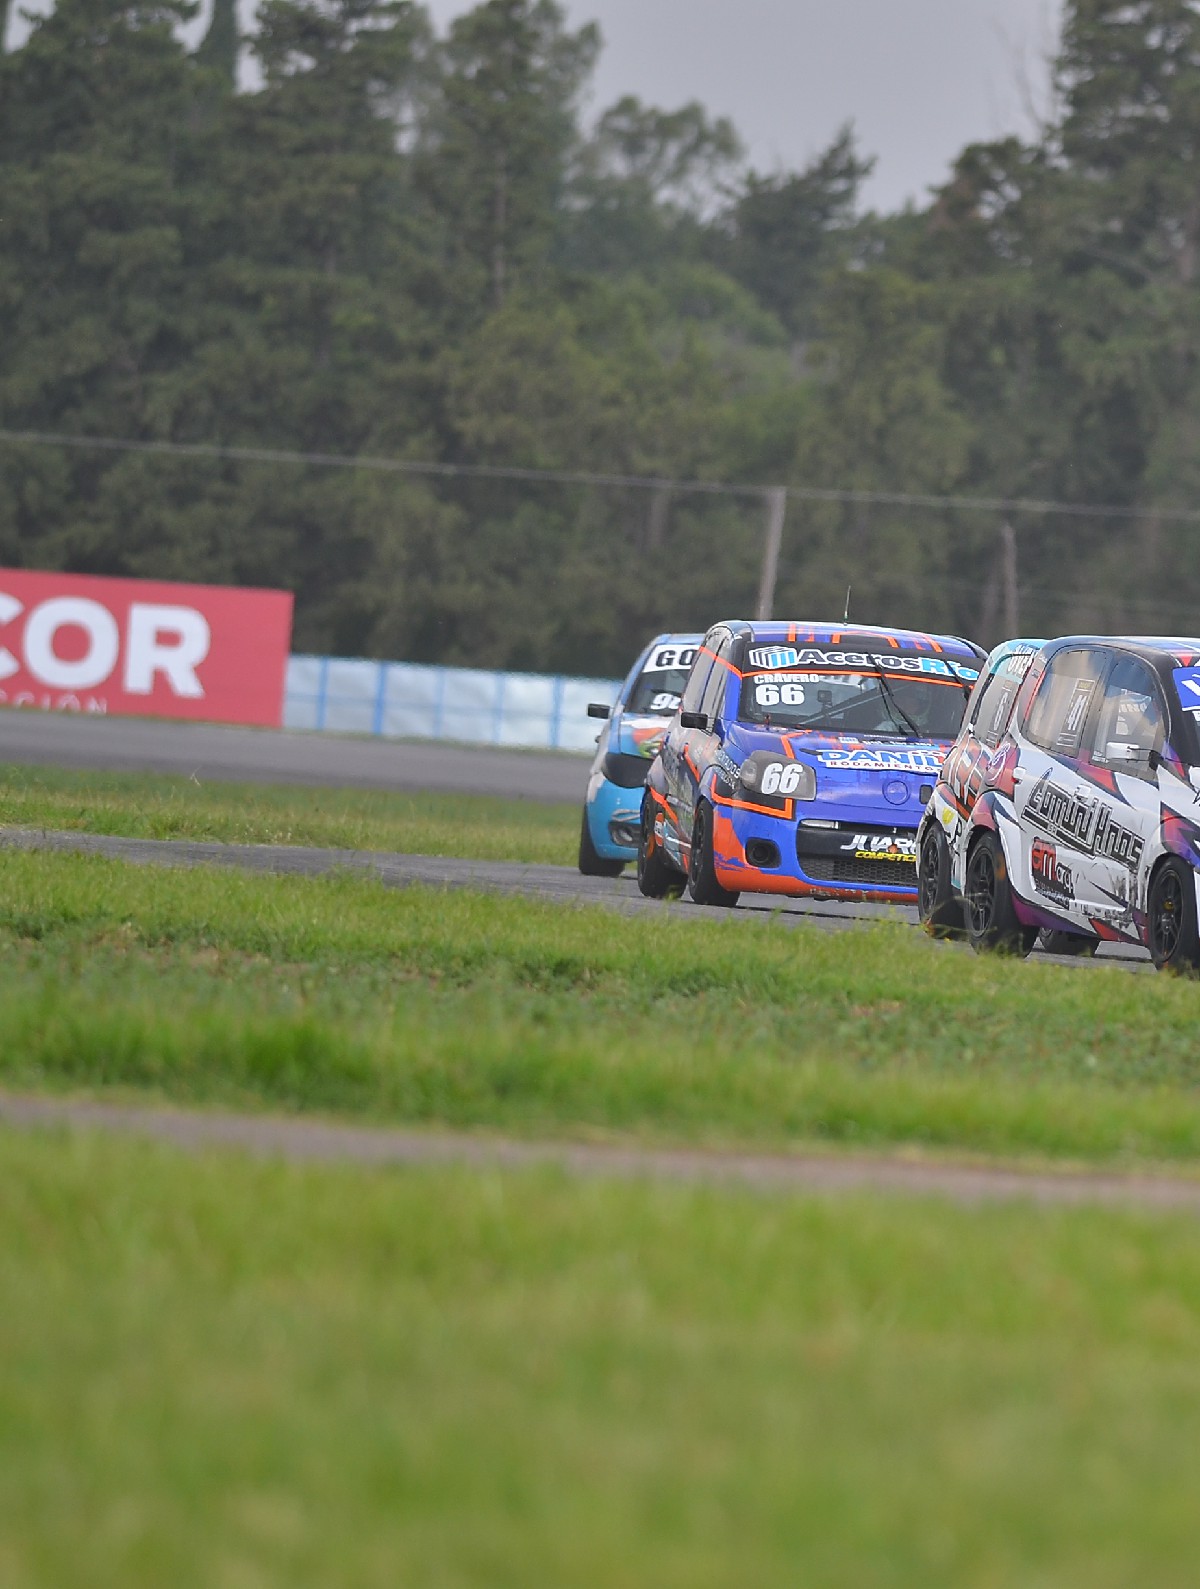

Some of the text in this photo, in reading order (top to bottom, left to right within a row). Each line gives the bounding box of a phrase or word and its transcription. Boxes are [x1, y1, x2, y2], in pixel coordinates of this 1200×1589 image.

[754, 673, 820, 684] CRAVERO
[755, 684, 805, 706] 66
[830, 760, 941, 771] RODAMIENTO
[761, 763, 803, 794] 66
